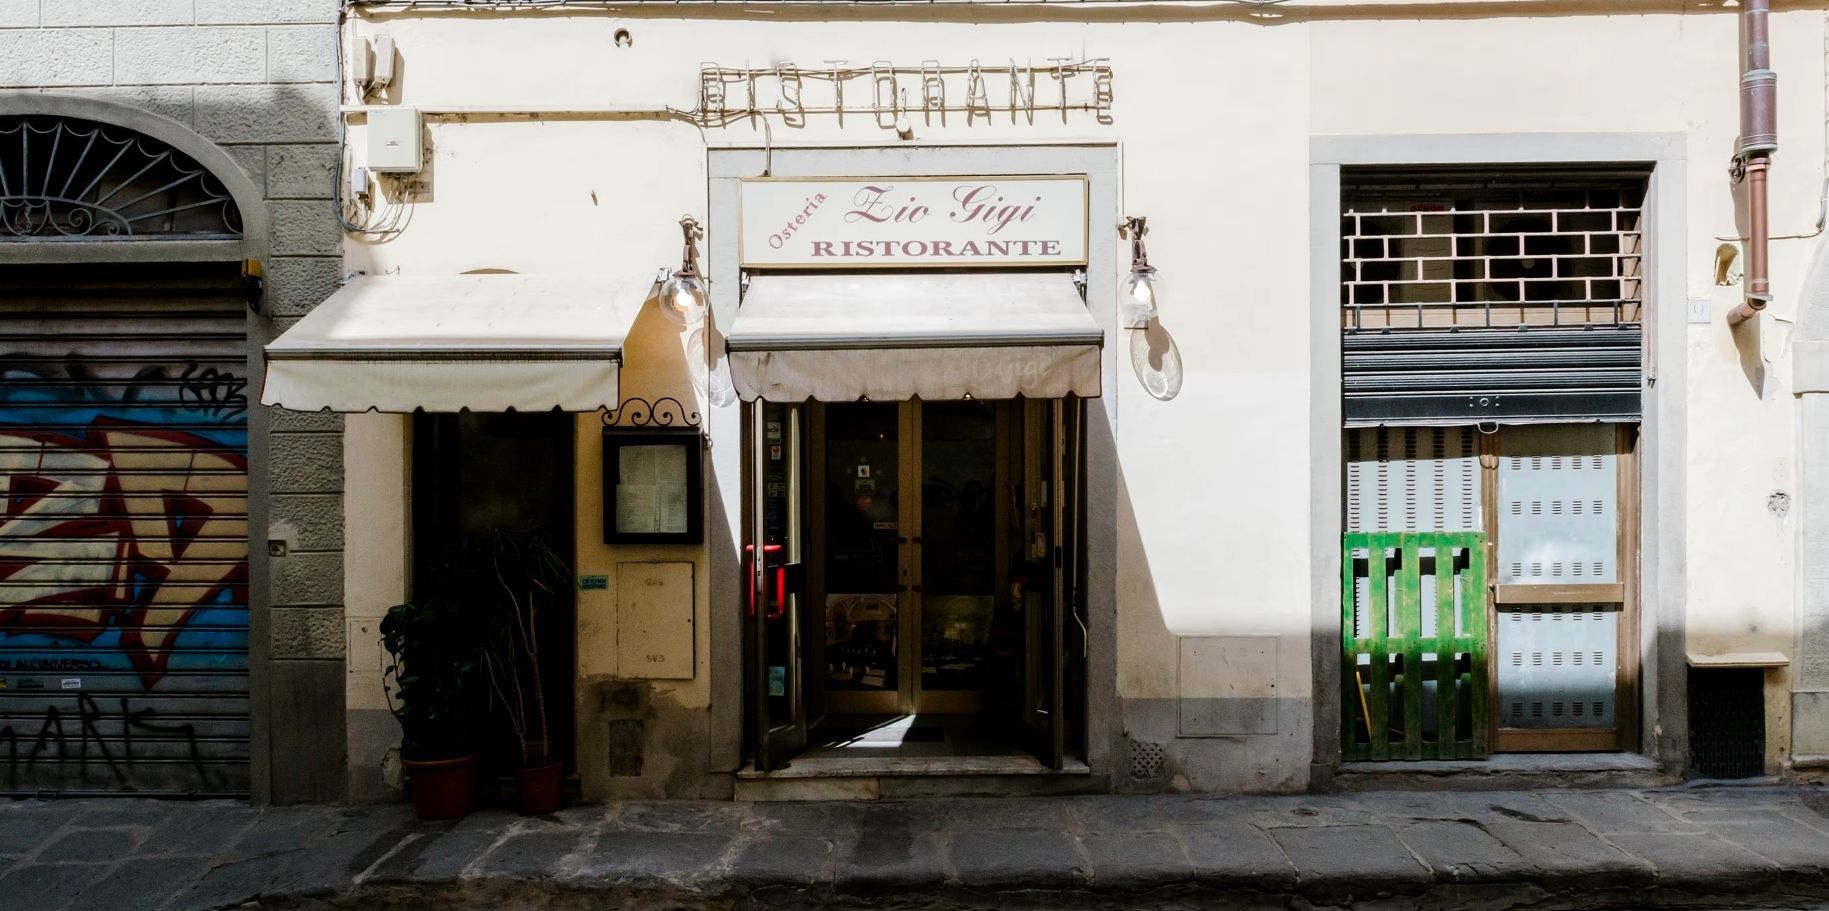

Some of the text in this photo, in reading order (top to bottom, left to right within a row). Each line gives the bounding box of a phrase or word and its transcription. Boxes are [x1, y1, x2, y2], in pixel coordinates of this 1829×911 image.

[698, 56, 1113, 114] RISTORANTE
[768, 191, 828, 250] Osteria
[844, 184, 1043, 236] Zio Gigi
[810, 239, 1063, 258] RISTORANTE
